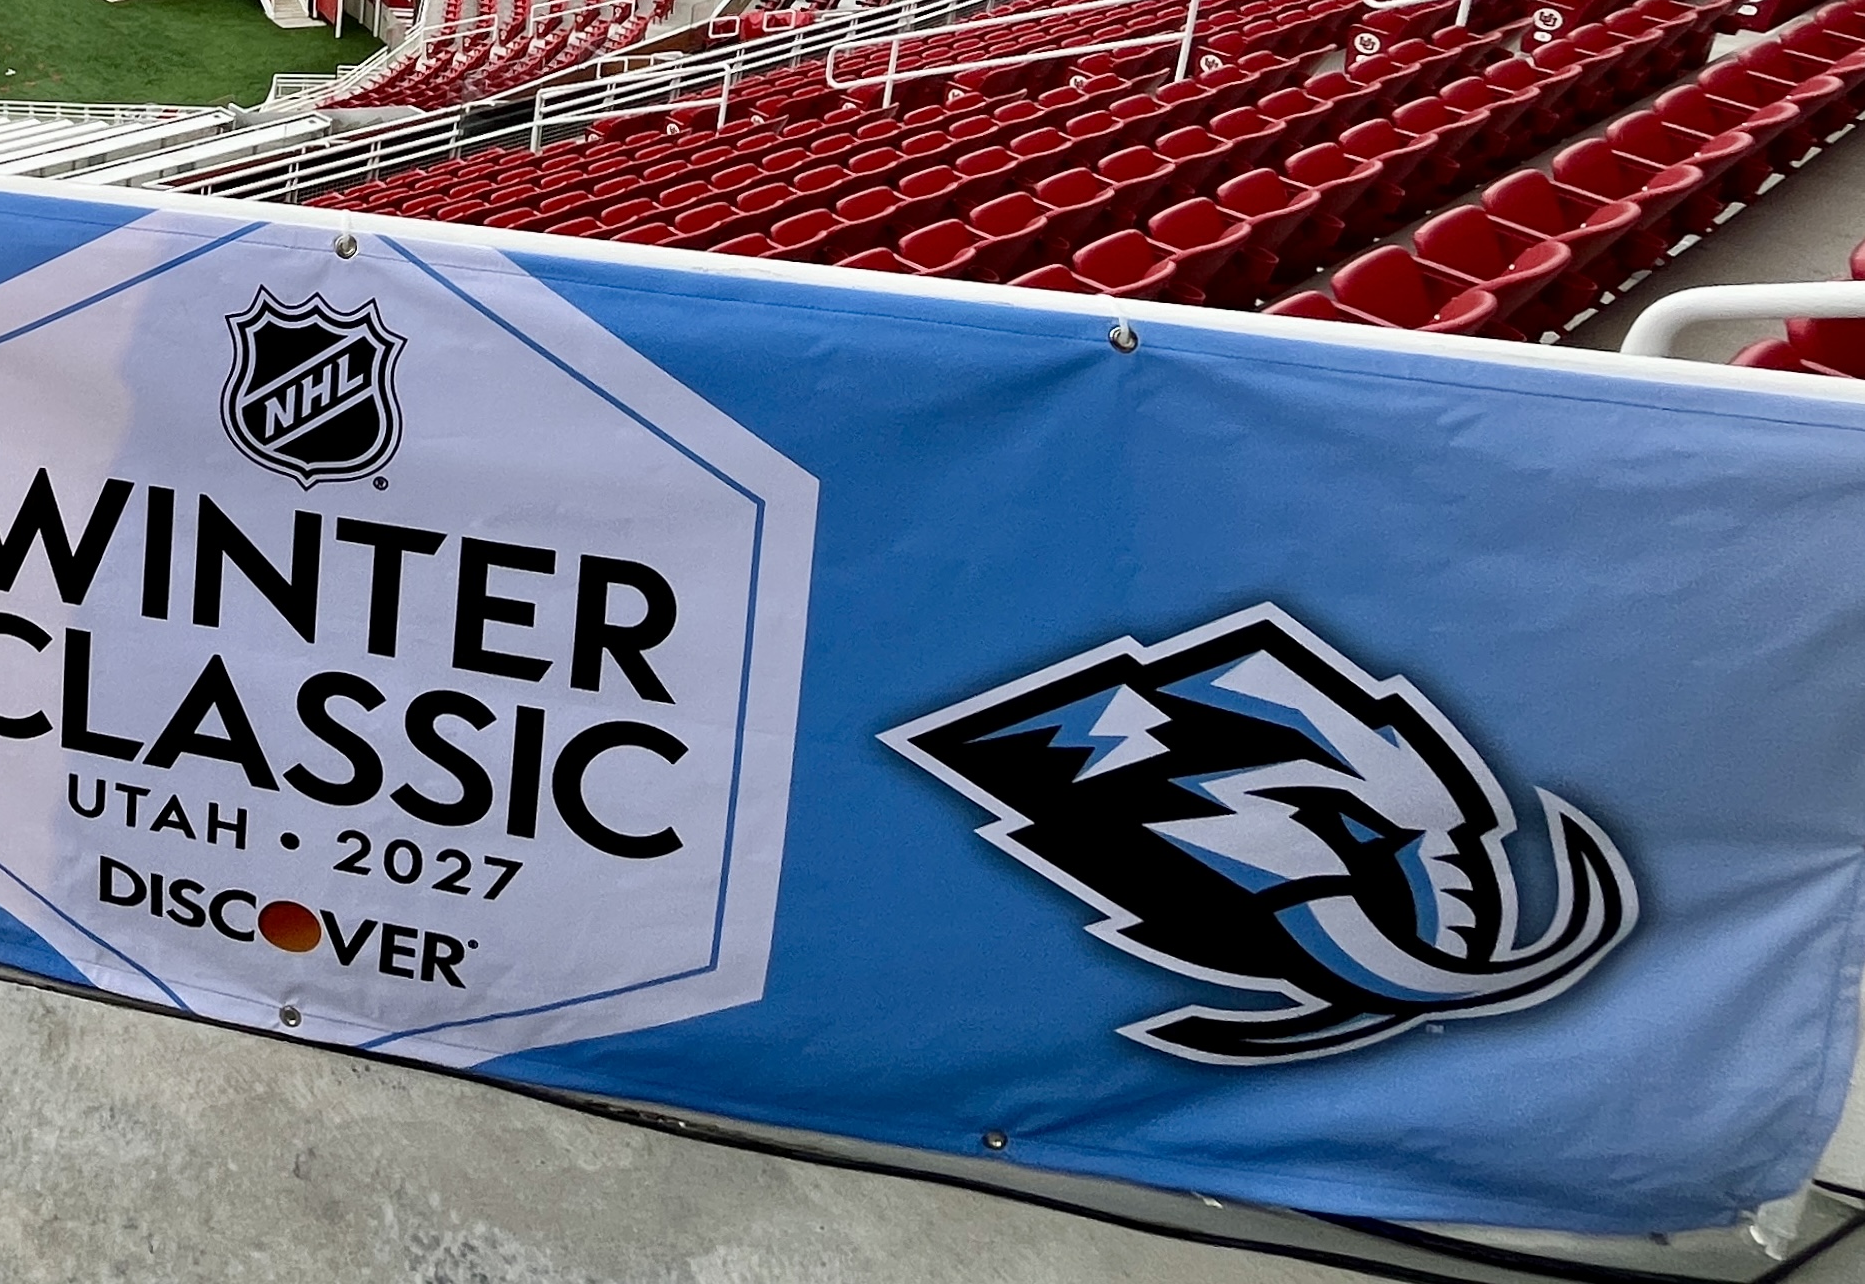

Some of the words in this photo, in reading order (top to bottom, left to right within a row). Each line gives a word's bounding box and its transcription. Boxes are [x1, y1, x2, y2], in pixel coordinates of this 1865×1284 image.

[263, 352, 368, 440] NHL
[67, 772, 249, 850] UTAH
[332, 828, 524, 902] 2027
[97, 855, 469, 989] DISCOVER
